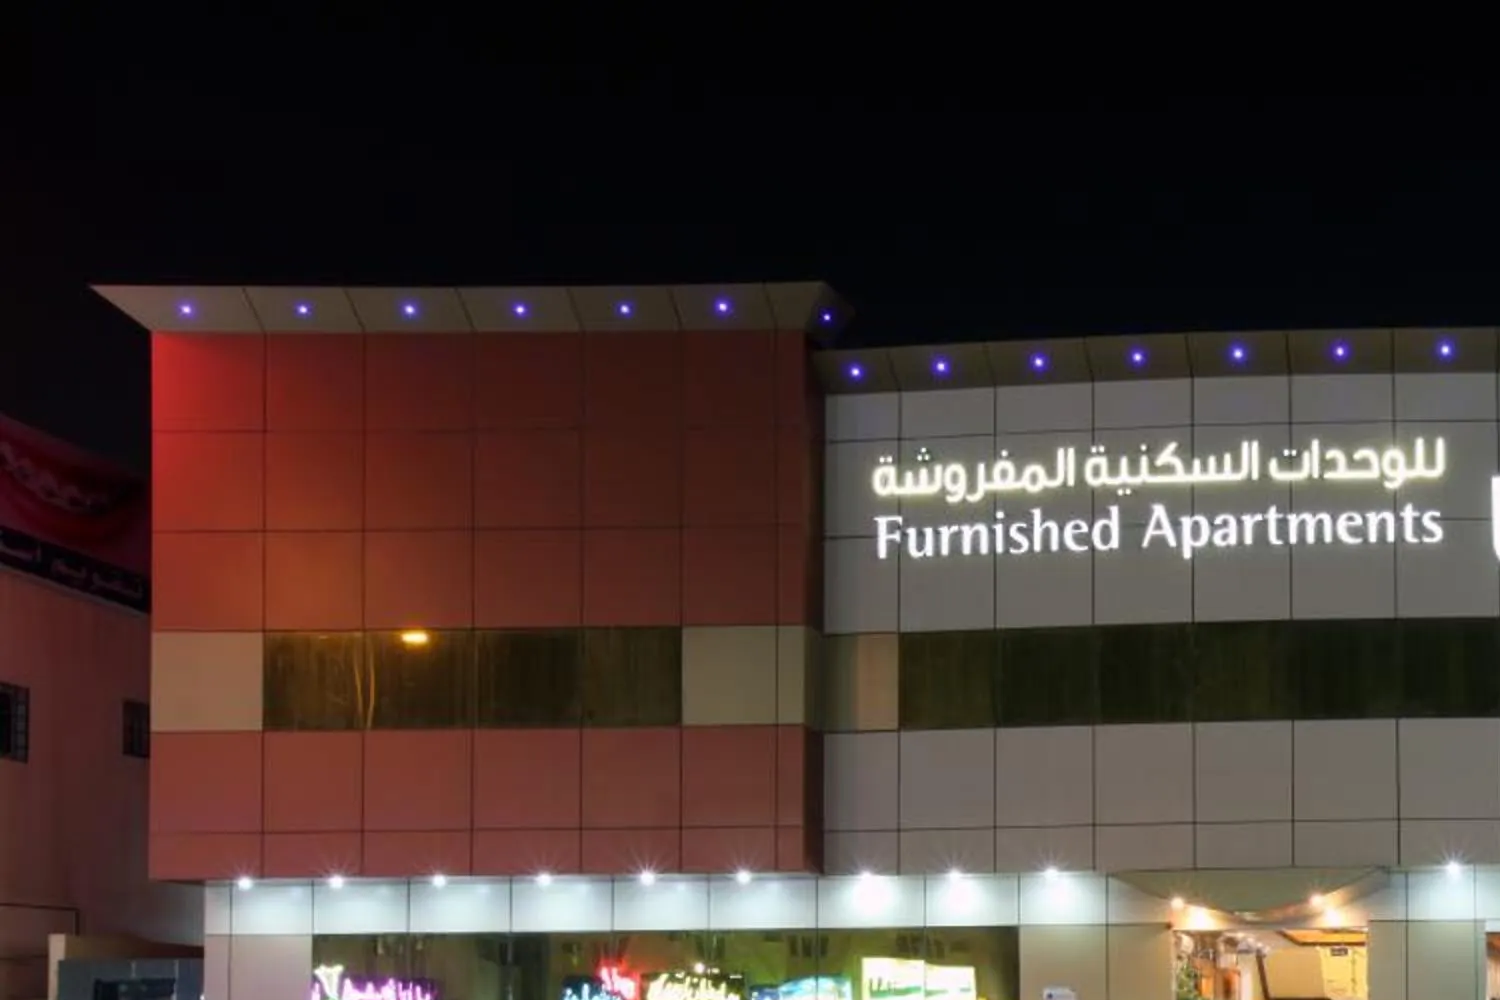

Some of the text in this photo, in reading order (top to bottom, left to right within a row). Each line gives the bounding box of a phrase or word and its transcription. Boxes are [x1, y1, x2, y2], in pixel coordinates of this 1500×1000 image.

[872, 436, 1446, 504] للوحدات السكنية المفروشة
[873, 503, 1444, 560] Furnished Apartments
